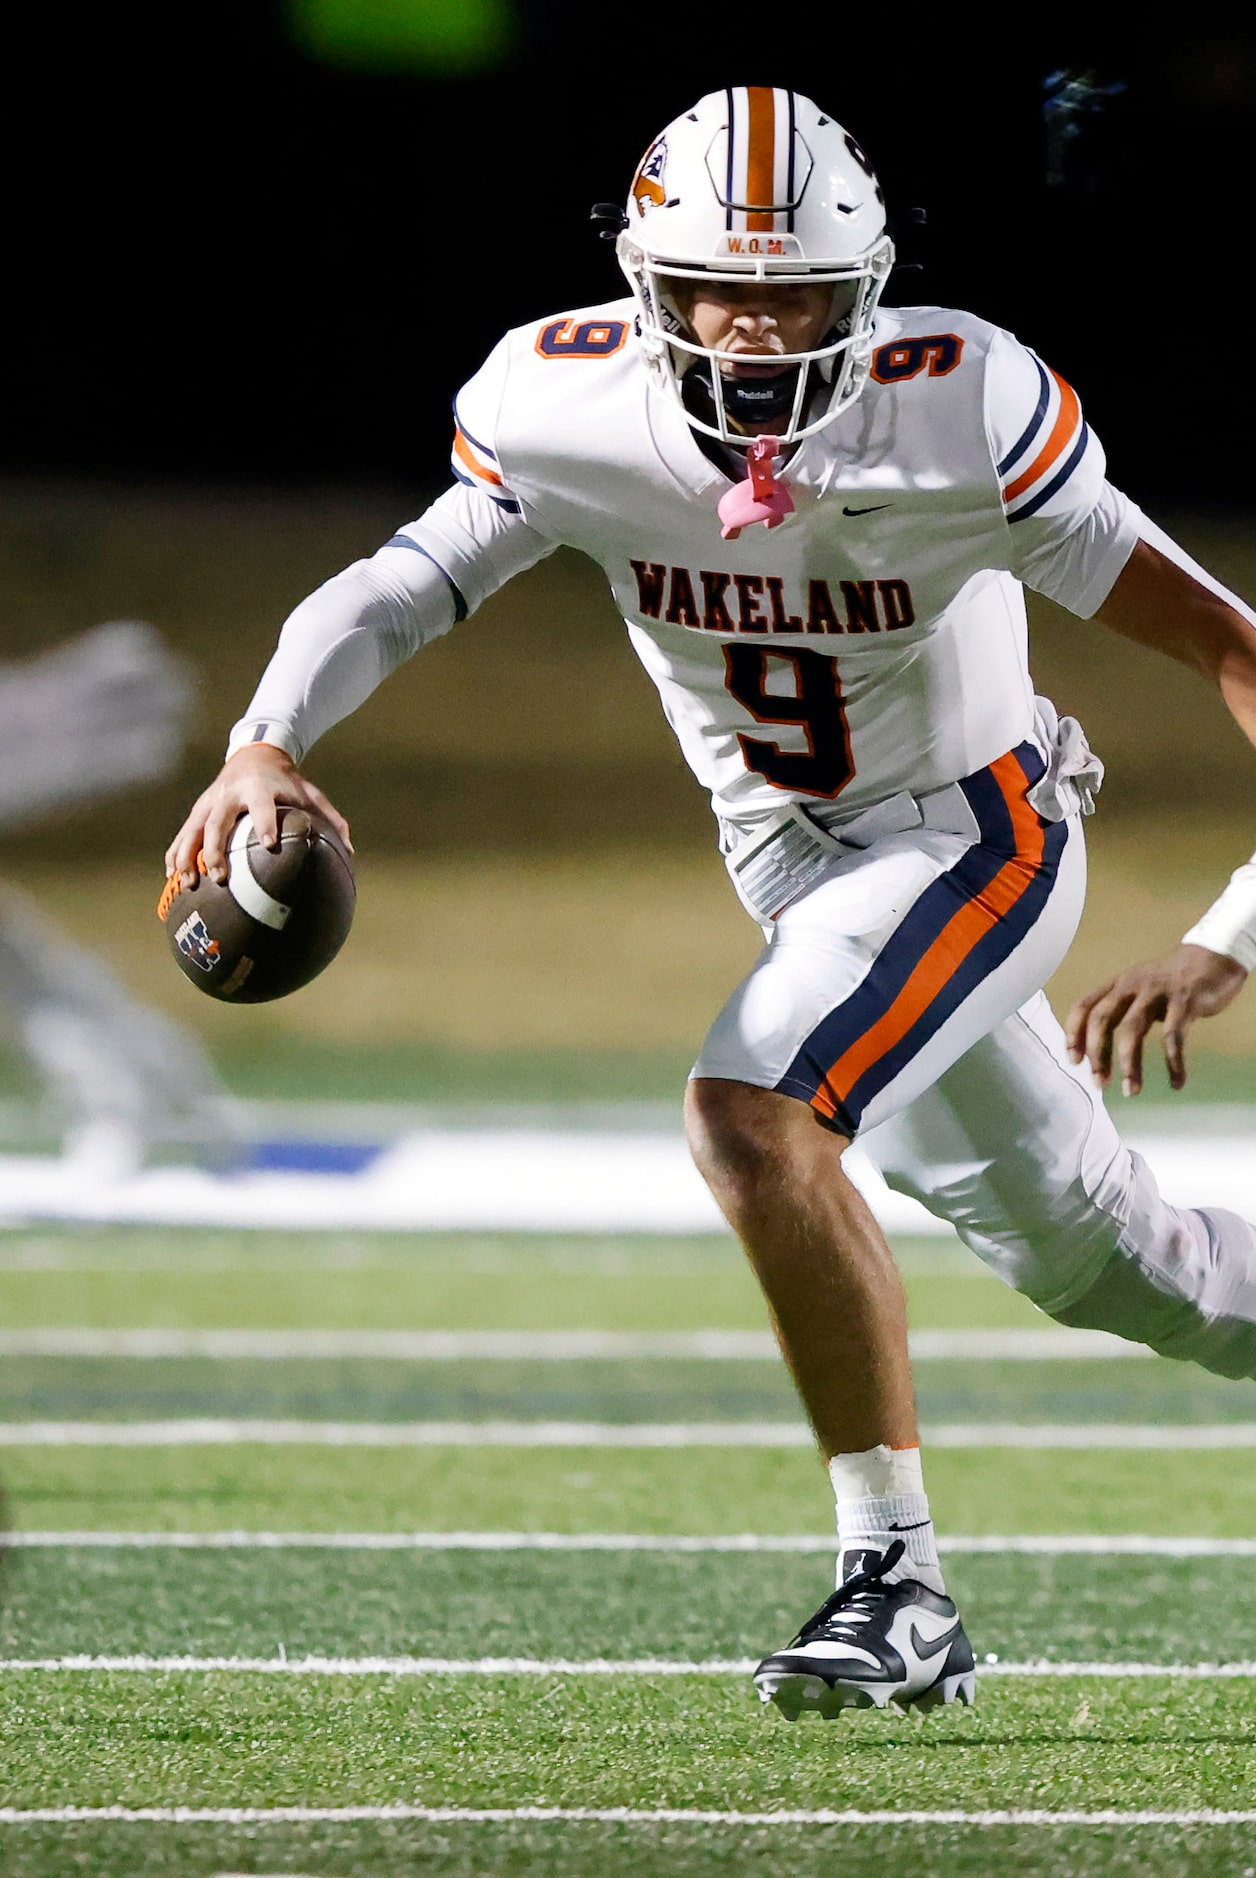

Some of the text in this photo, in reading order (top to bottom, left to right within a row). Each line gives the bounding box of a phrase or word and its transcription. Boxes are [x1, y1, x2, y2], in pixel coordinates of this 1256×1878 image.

[533, 317, 631, 360] 9
[870, 333, 964, 385] 9
[629, 559, 915, 634] WAKELAND
[721, 642, 856, 800] 9
